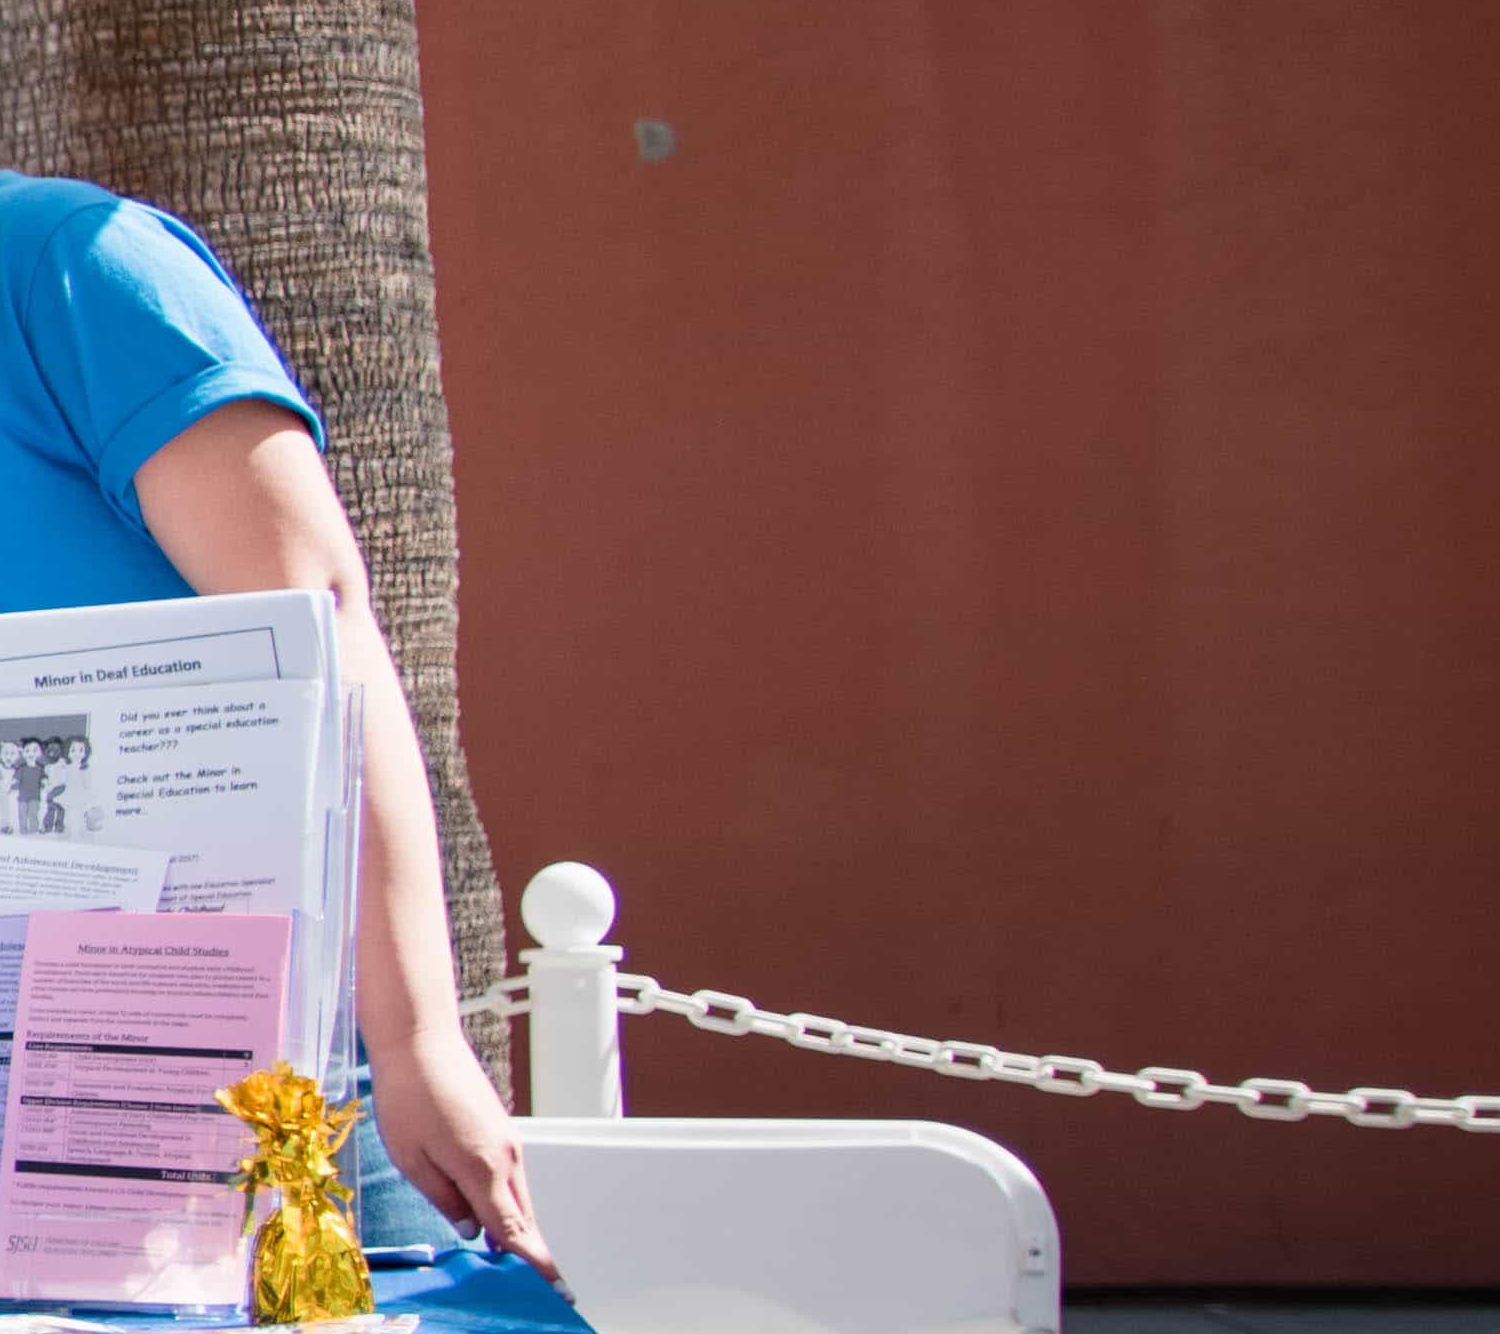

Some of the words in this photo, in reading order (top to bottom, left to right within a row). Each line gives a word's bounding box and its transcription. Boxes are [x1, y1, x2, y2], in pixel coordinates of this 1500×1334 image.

[34, 674, 77, 689] Minor
[79, 671, 94, 685] in
[96, 666, 129, 683] Deaf
[131, 658, 202, 678] Education
[120, 711, 138, 723] Did
[142, 712, 161, 723] you
[164, 709, 188, 719] ever
[192, 703, 220, 715] think
[223, 701, 255, 714] about
[258, 701, 266, 711] a
[119, 728, 154, 739] career
[158, 725, 171, 736] as
[174, 725, 182, 735] a
[185, 720, 222, 735] special
[225, 715, 280, 730] education
[116, 773, 149, 787] Check
[152, 772, 171, 784] out
[174, 769, 193, 782] the
[196, 766, 228, 780] Minor
[231, 765, 242, 777] in
[116, 788, 155, 803] Special
[158, 783, 211, 800] Education
[214, 782, 227, 795] to
[229, 780, 259, 794] learn
[77, 943, 107, 956] Minor
[108, 945, 120, 956] in
[121, 944, 163, 959] Atypical
[164, 945, 191, 957] Child
[192, 946, 230, 958] Studies
[160, 1169, 187, 1181] Total
